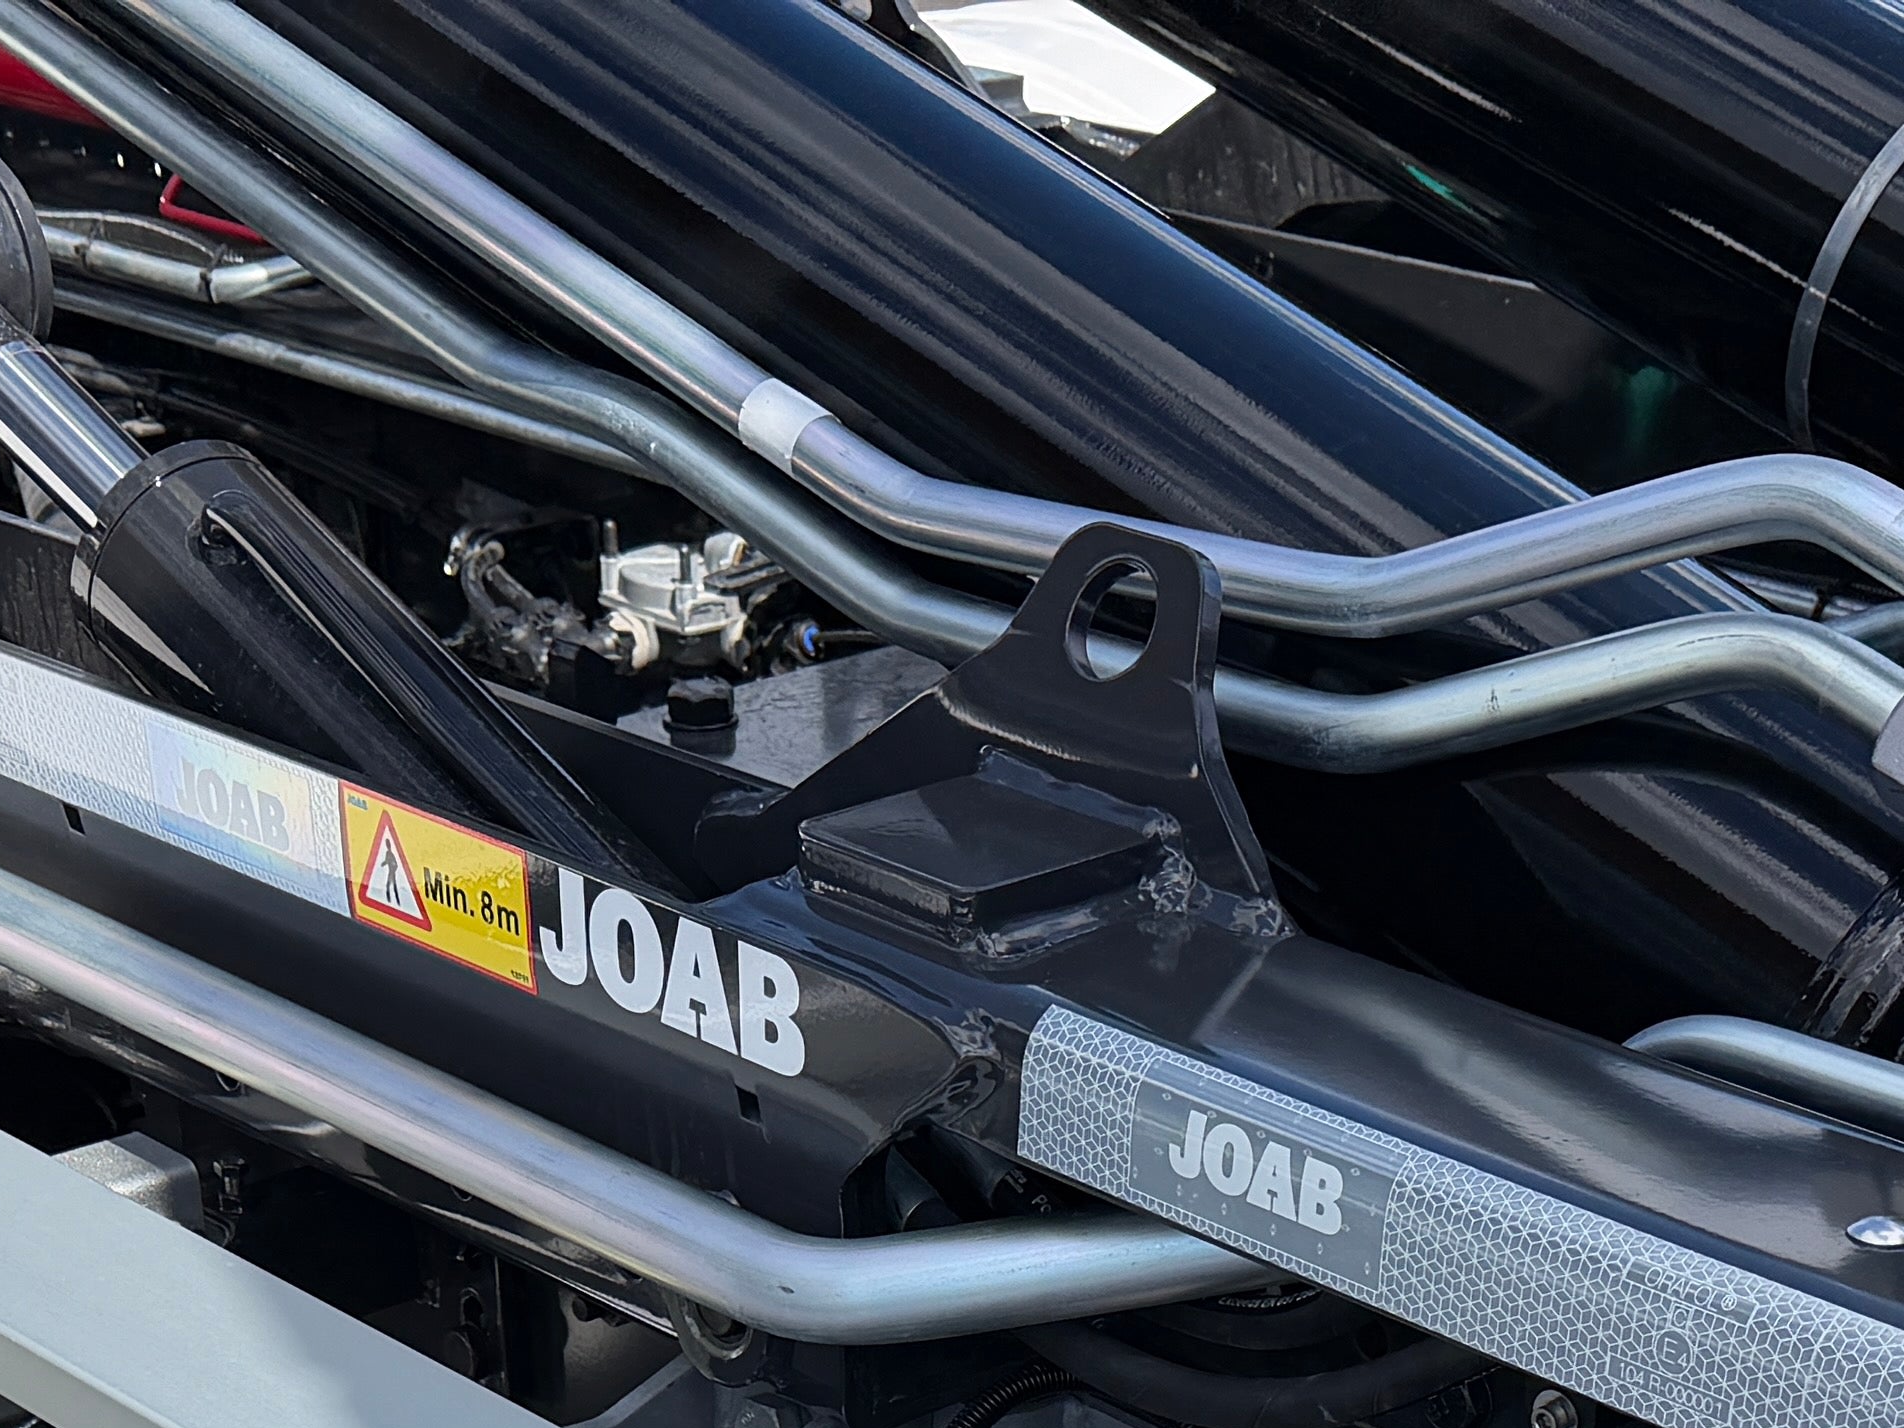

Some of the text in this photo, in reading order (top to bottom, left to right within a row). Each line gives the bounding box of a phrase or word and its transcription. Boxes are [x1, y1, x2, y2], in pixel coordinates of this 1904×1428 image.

[175, 760, 289, 854] JOAB
[423, 866, 475, 917] Min.
[539, 867, 806, 1078] JOAB
[1167, 1109, 1344, 1237] JOAB
[1619, 1362, 1645, 1387] 104
